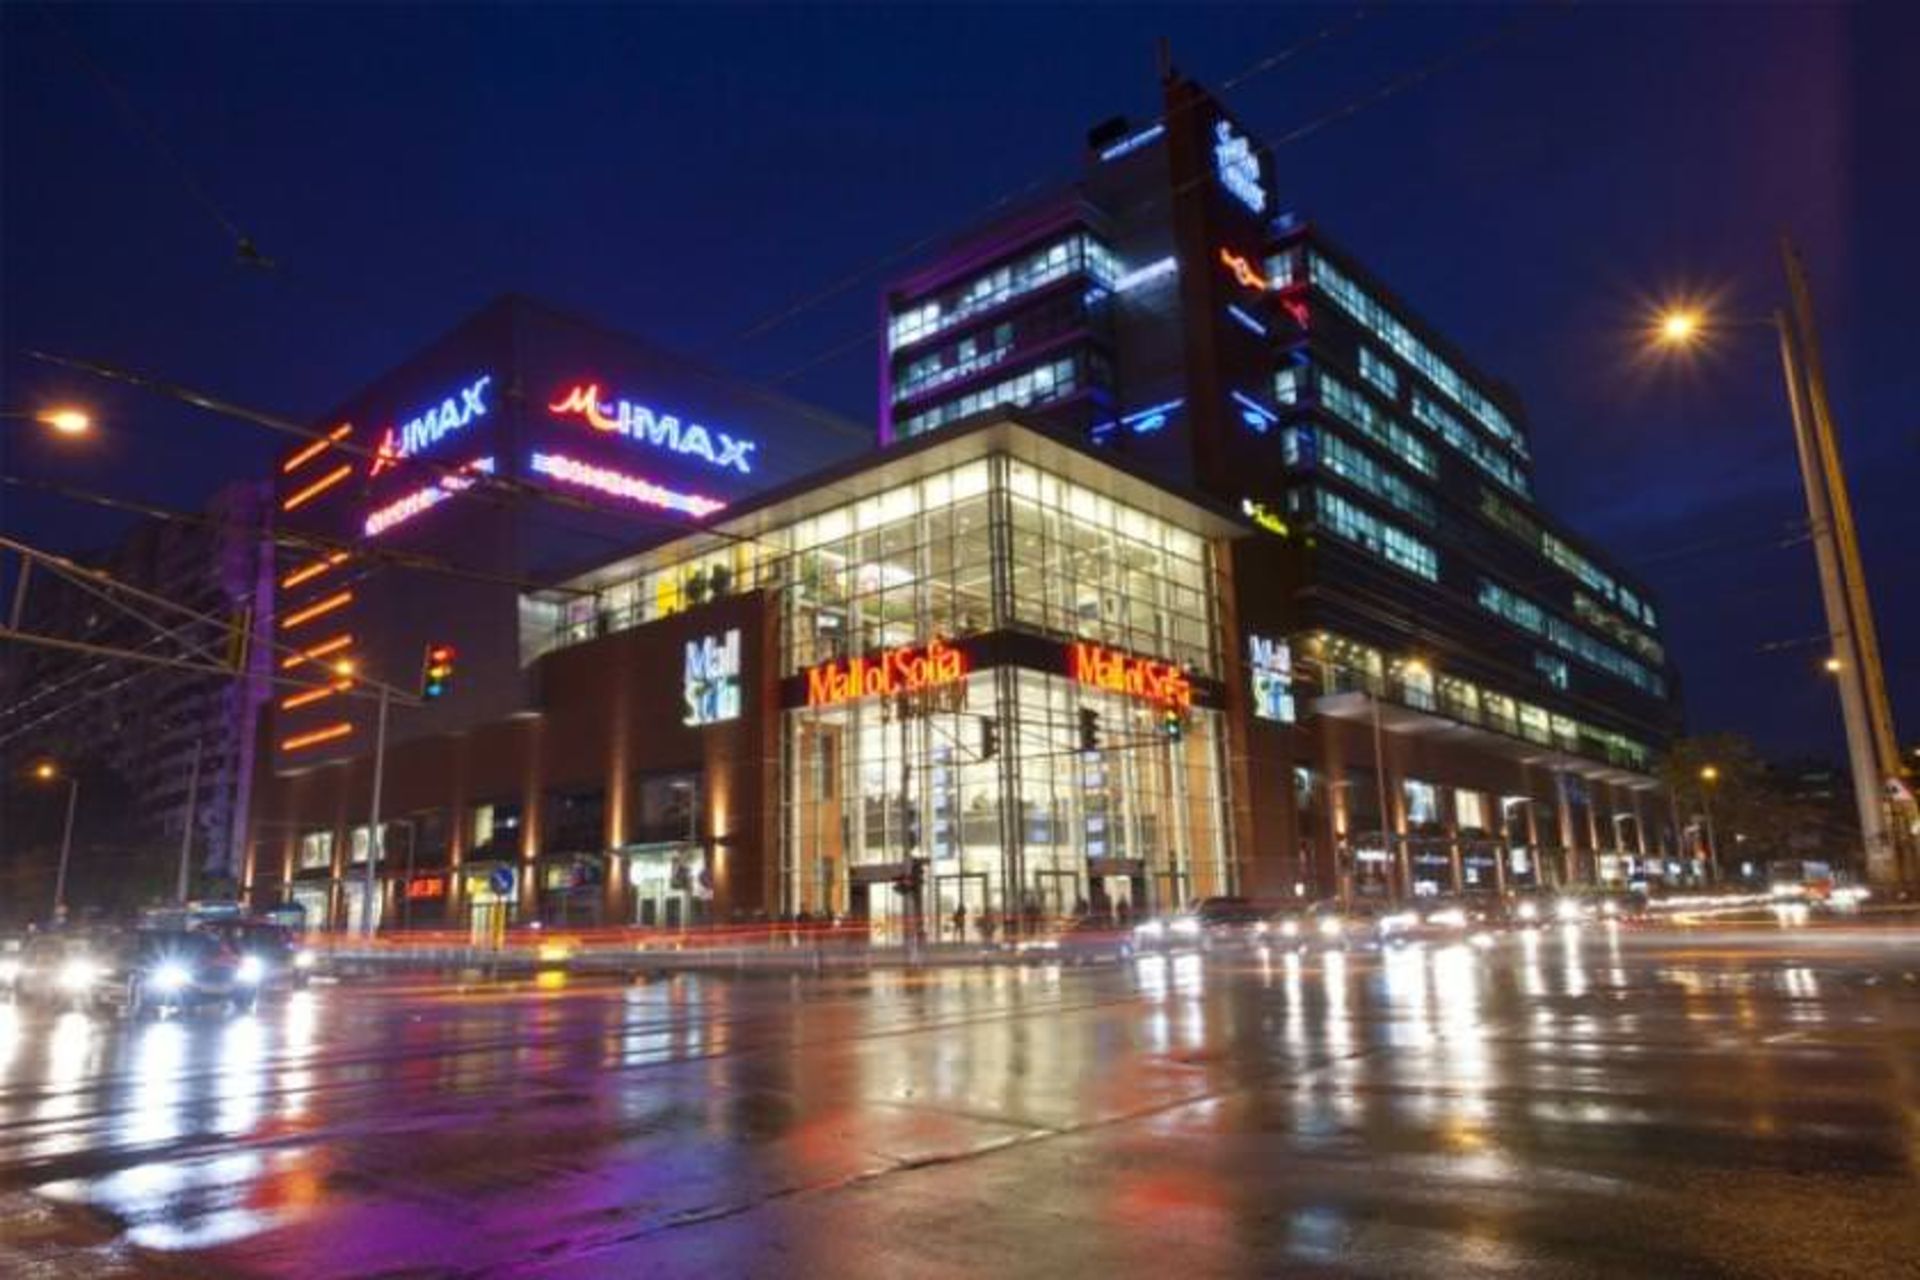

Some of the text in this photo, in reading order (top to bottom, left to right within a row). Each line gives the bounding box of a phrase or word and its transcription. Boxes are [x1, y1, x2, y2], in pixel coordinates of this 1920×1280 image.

[808, 640, 961, 707] Mall of Sofia
[1076, 642, 1124, 691] Mall
